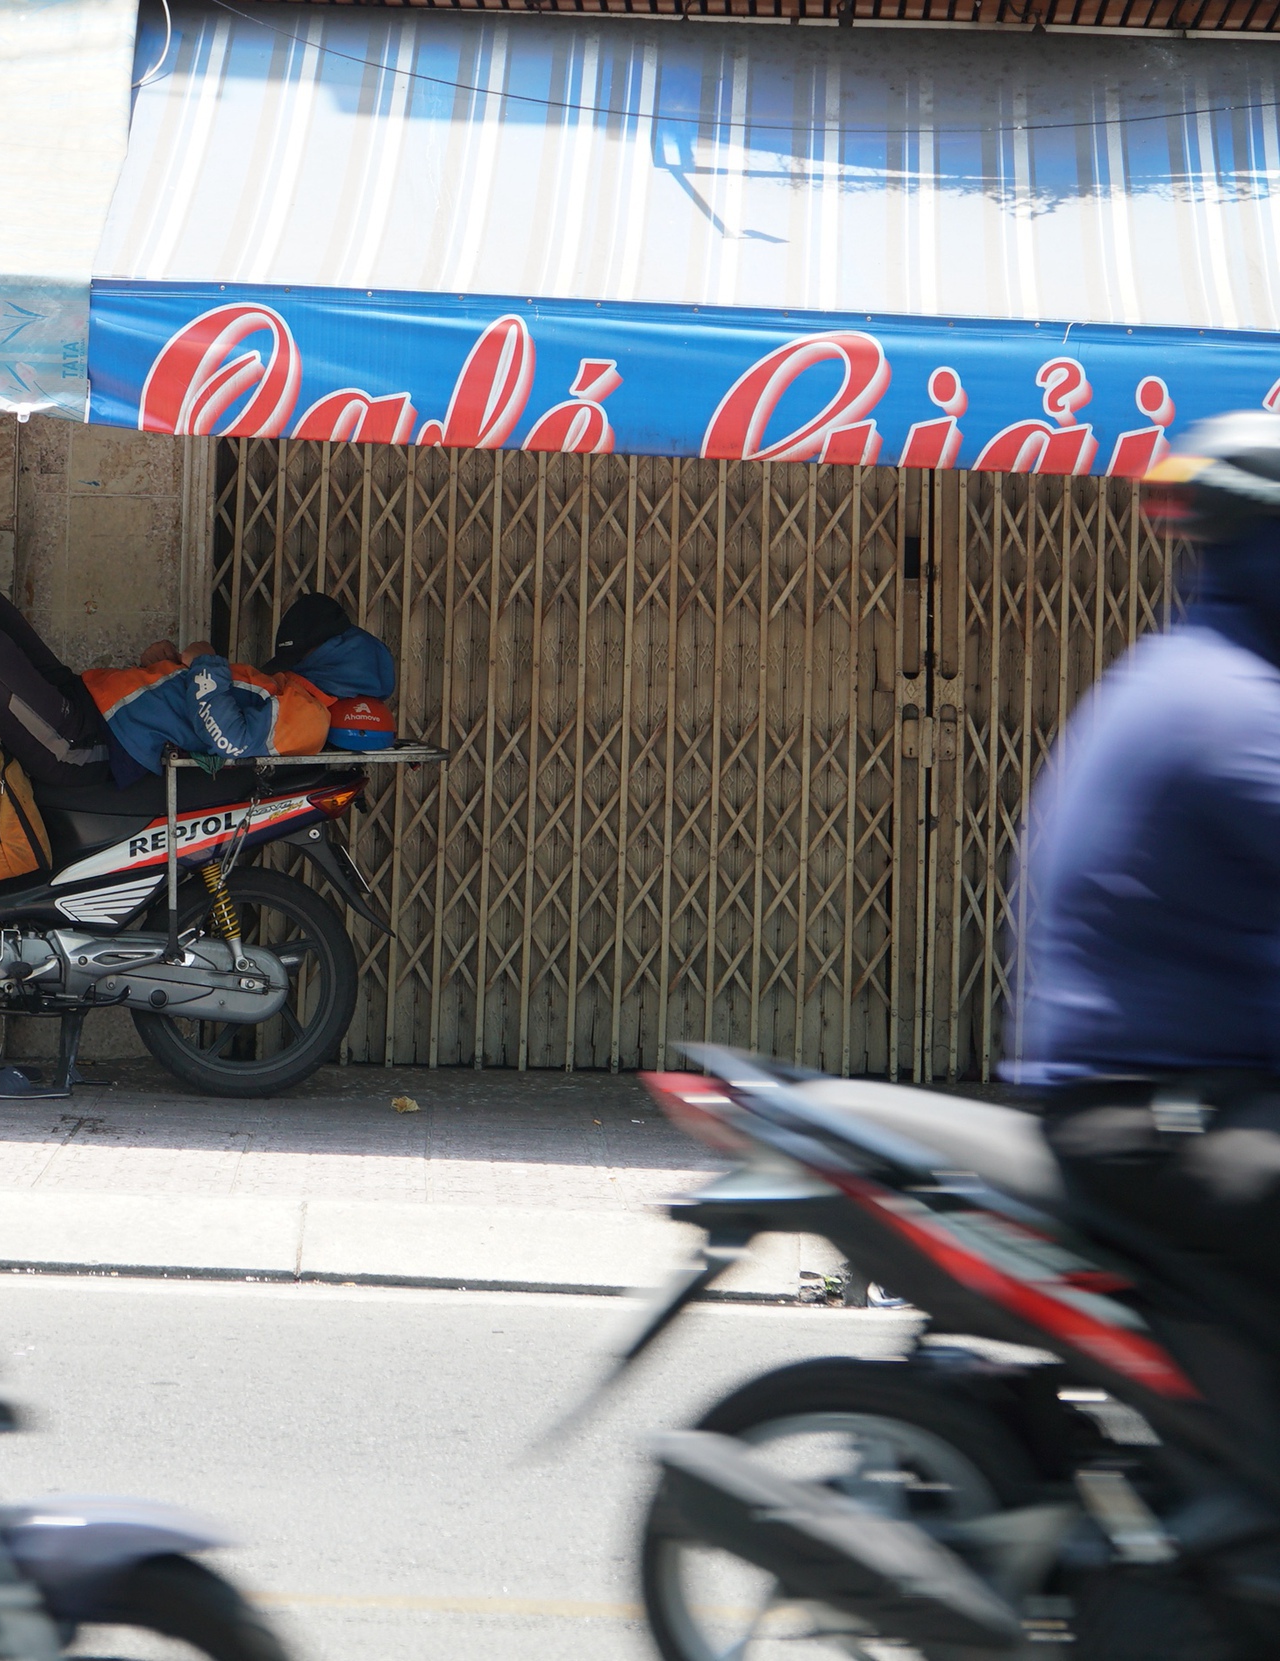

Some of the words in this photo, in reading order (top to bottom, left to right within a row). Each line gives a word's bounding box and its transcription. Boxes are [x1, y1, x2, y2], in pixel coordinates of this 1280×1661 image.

[62, 341, 79, 379] TATA
[344, 713, 381, 723] Ahamove
[129, 812, 237, 857] REPSOL
